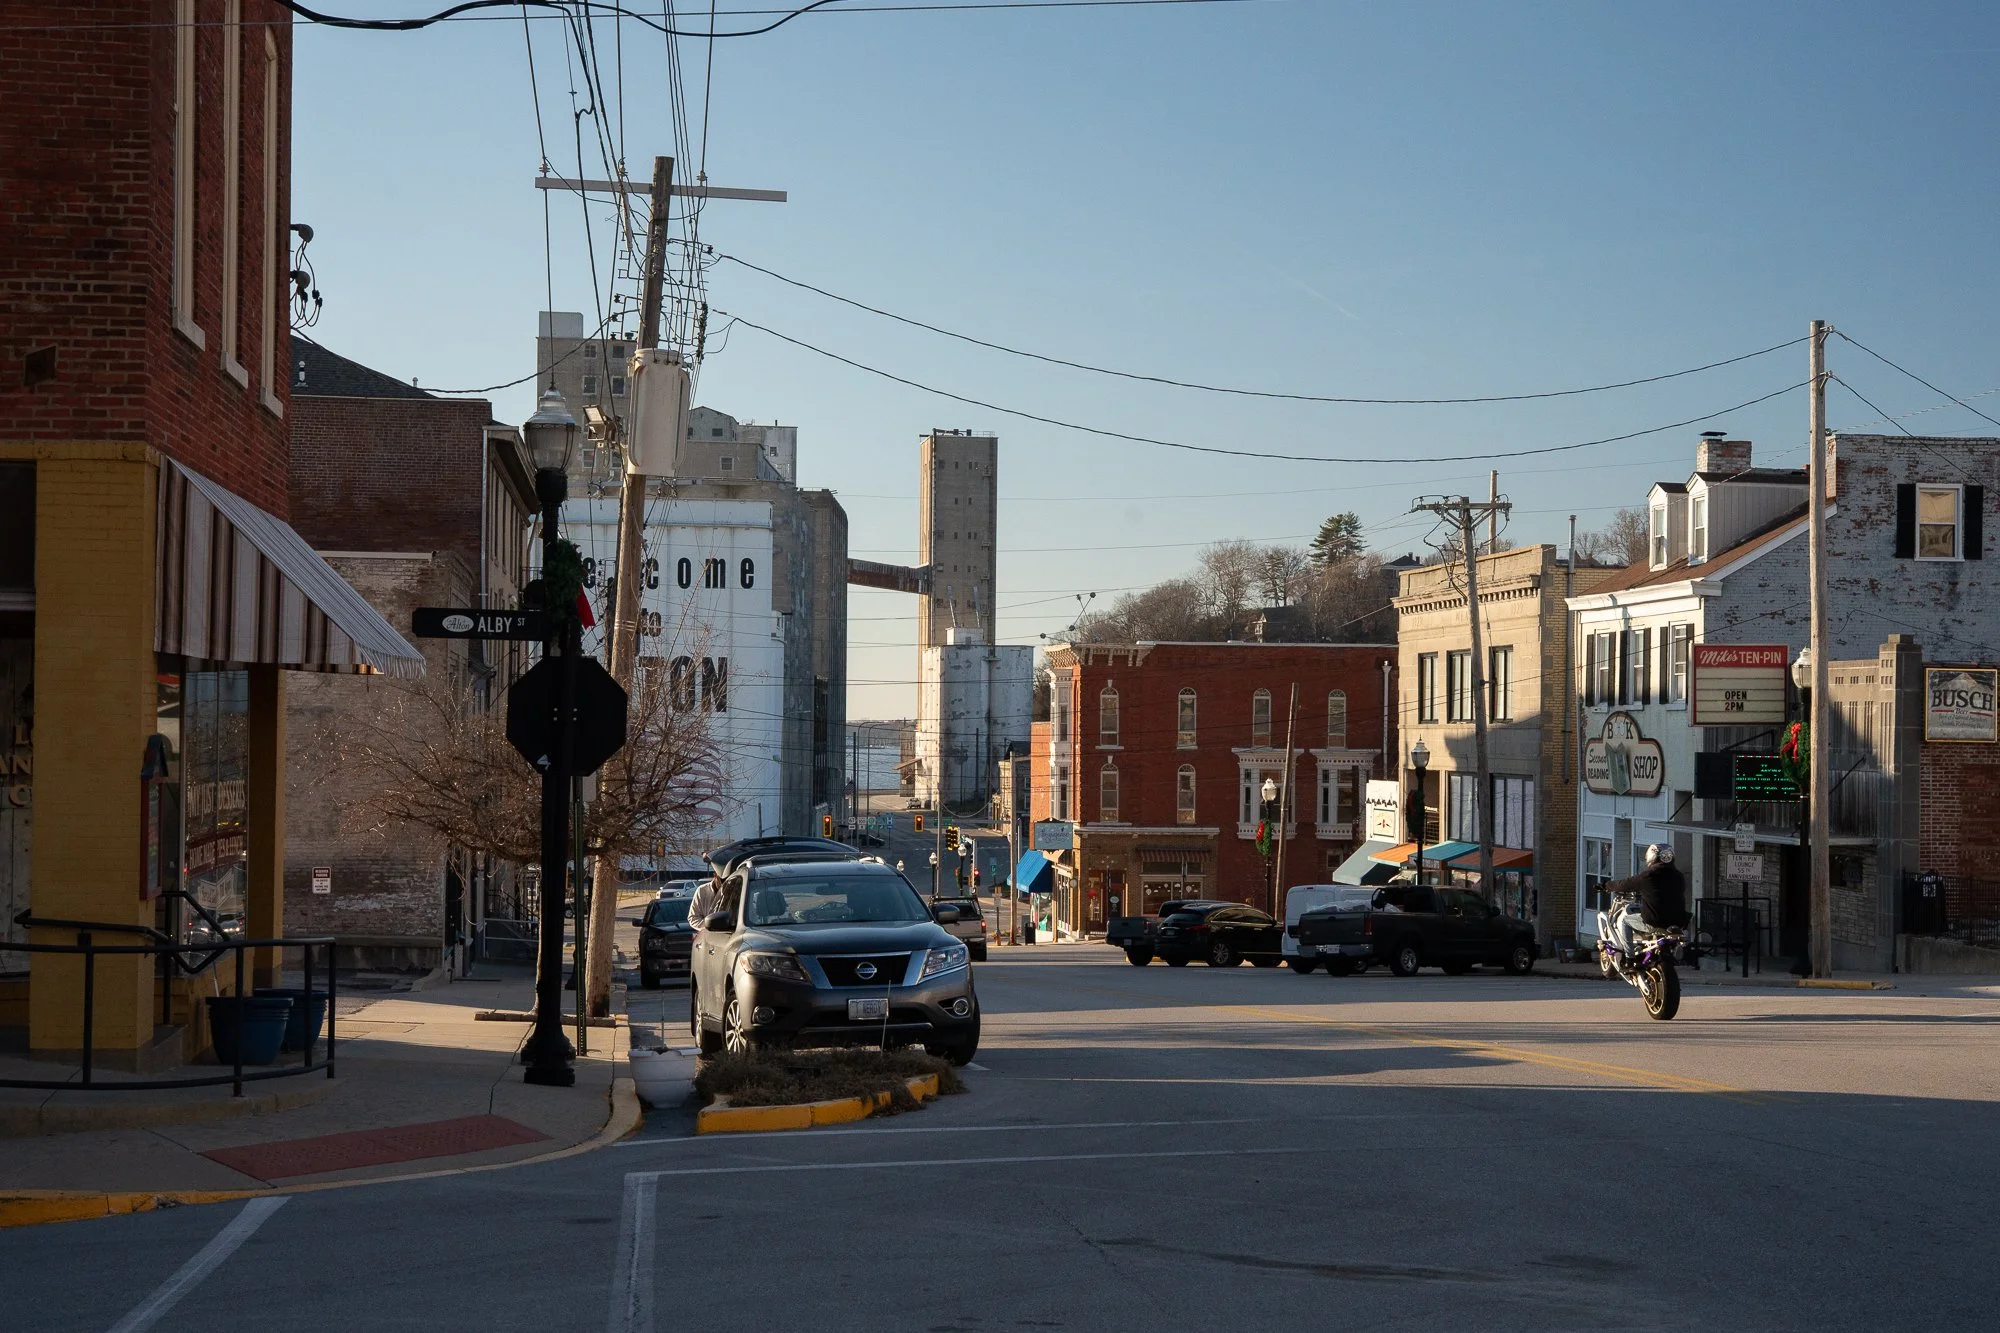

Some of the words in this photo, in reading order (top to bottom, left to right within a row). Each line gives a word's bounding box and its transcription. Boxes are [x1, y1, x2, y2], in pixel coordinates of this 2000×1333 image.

[477, 616, 512, 633] ALBY
[517, 617, 525, 627] ST
[1700, 650, 1738, 666] Mike's
[1739, 651, 1782, 664] TEN-PIN
[1724, 690, 1748, 701] OPEN
[1931, 689, 1994, 711] BUSCH
[1724, 702, 1744, 711] 2PM
[1587, 768, 1609, 780] READING
[1633, 755, 1659, 779] SHOP
